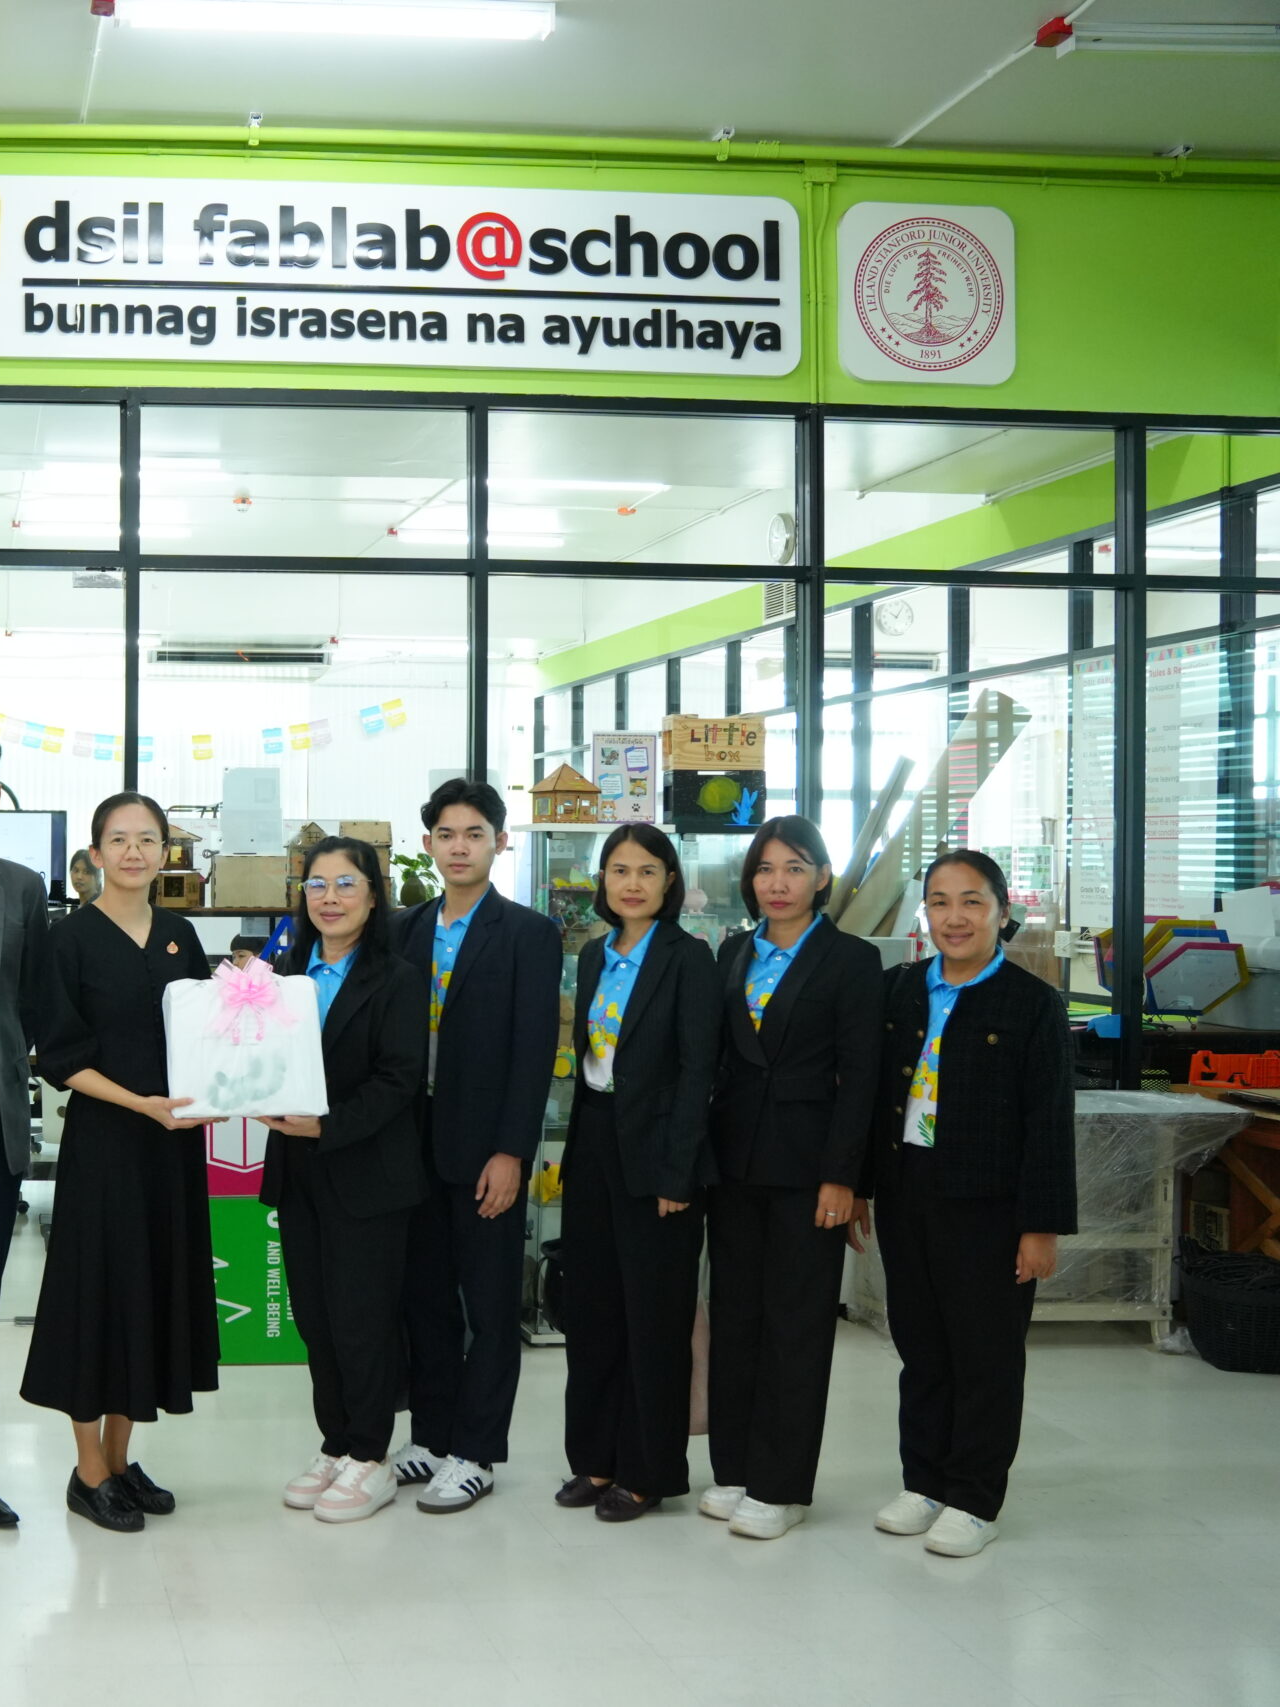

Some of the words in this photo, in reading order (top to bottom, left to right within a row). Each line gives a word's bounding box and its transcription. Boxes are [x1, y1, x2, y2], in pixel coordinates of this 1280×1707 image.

[24, 200, 163, 264] dsil
[193, 203, 781, 282] fablab@school
[876, 229, 925, 266] STANFORD
[927, 229, 967, 253] JUNIOR
[968, 249, 993, 316] UNIVERSITY
[883, 280, 891, 294] DIE
[887, 259, 902, 278] LUFT
[903, 249, 919, 260] DER
[937, 249, 966, 274] FREIHEIT
[964, 275, 975, 298] WEHT
[24, 293, 217, 346] bunnag
[236, 296, 448, 342] israsena
[466, 310, 526, 344] na
[542, 308, 782, 360] ayudhaya
[919, 349, 942, 360] 1891
[690, 723, 757, 746] Little
[704, 744, 741, 762] box
[267, 1240, 281, 1265] AND
[266, 1268, 281, 1338] WELL-BEING
